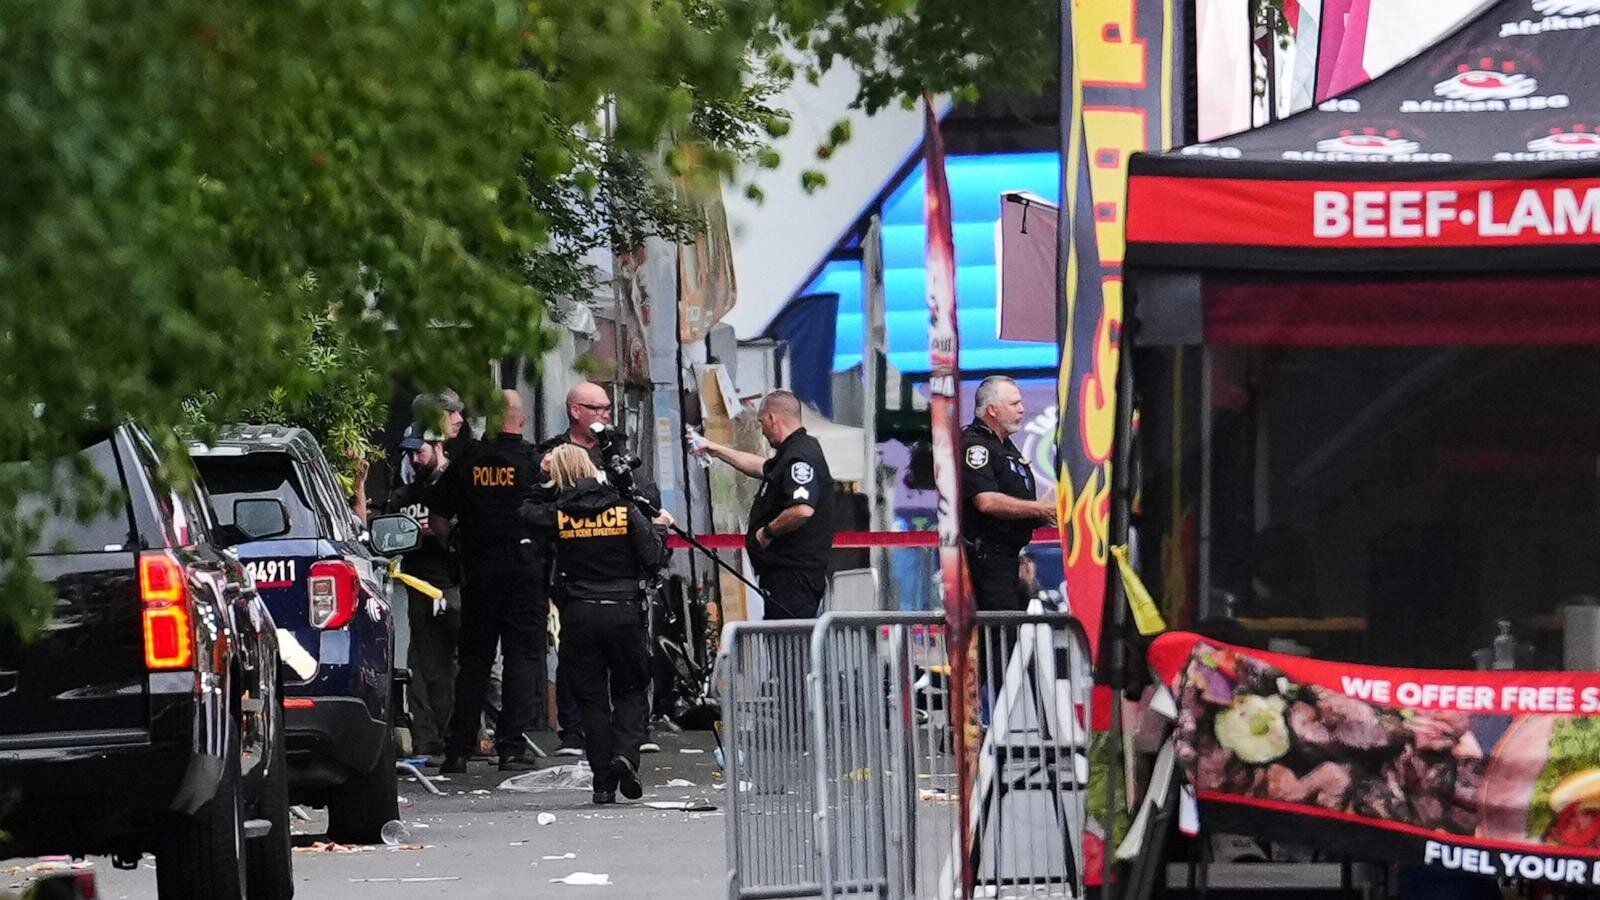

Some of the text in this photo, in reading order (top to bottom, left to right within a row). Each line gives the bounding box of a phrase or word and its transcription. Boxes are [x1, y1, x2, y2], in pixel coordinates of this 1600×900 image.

[1399, 100, 1506, 113] Afrikan
[473, 466, 516, 486] POLICE
[557, 506, 629, 530] POLICE
[1341, 676, 1600, 713] WE OFFER FREE S
[1424, 840, 1497, 875] FUEL
[1500, 852, 1588, 884] YOUR
